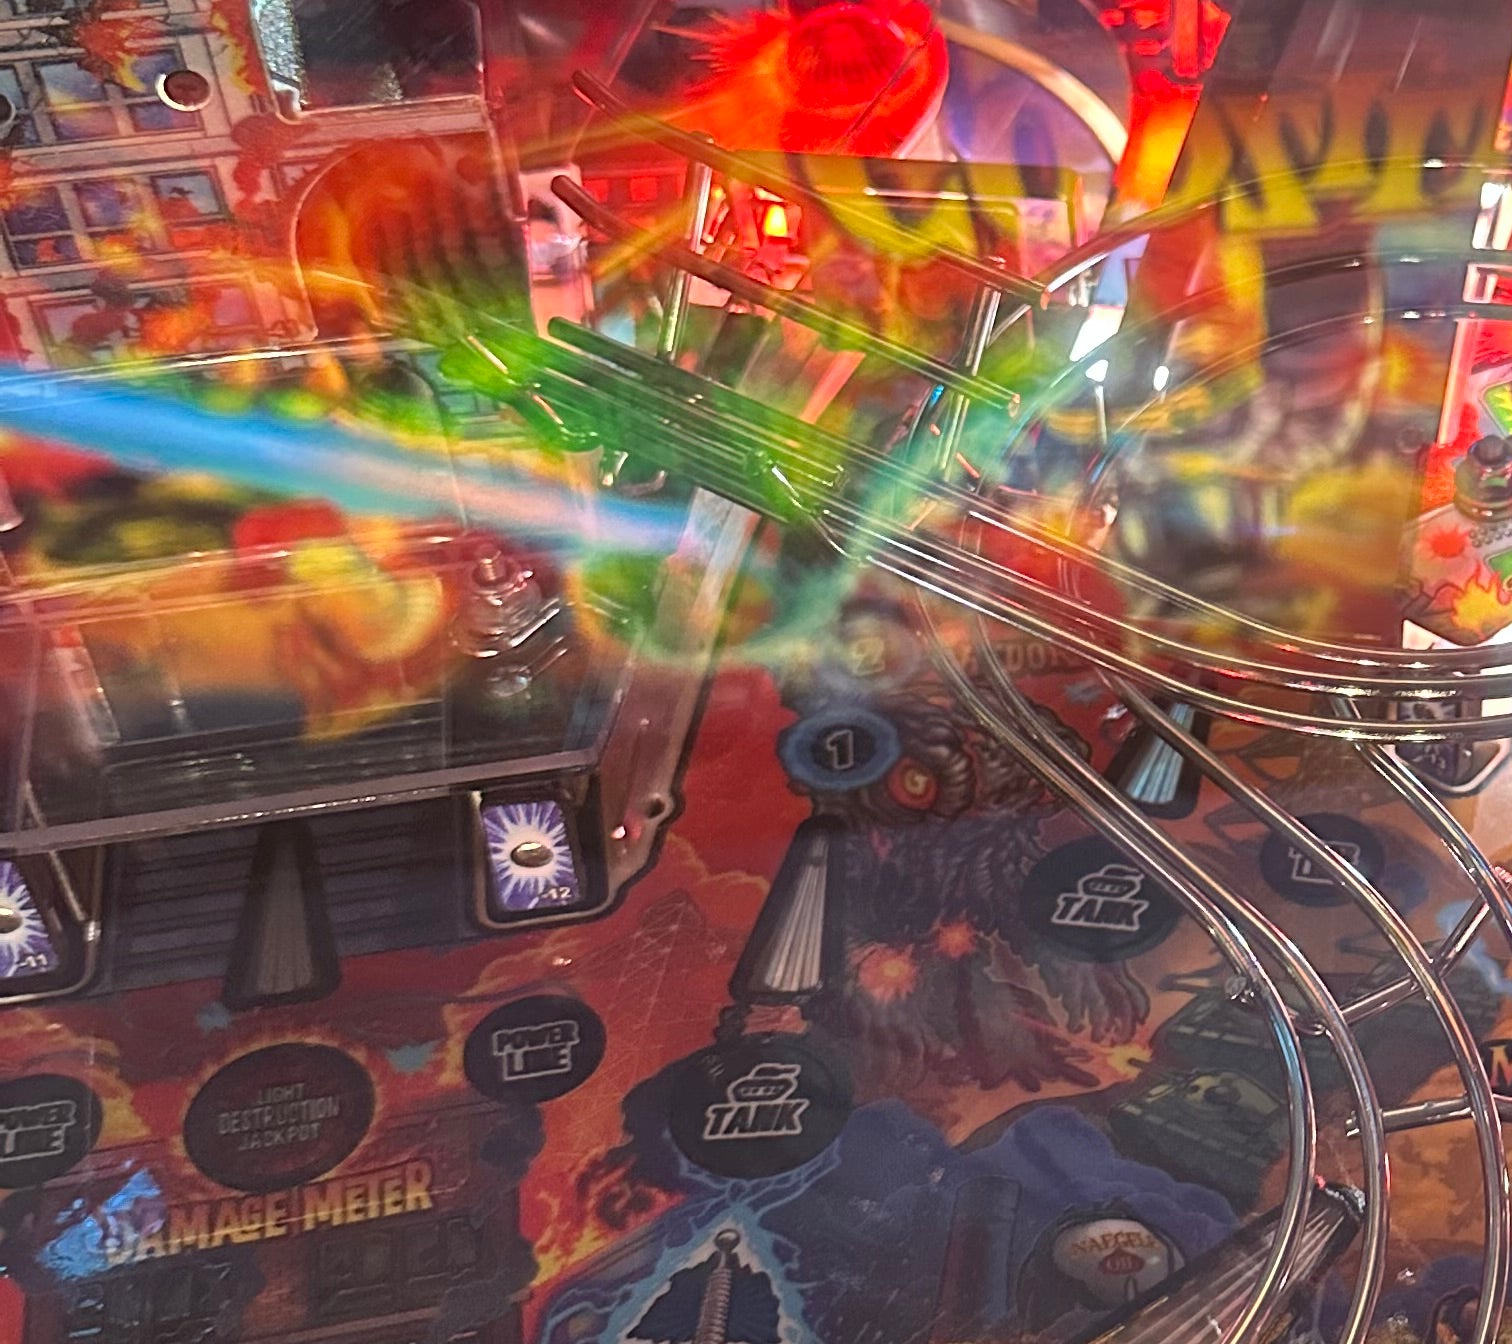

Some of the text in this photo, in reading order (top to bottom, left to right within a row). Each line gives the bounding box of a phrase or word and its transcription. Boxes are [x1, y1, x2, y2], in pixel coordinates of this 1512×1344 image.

[825, 728, 854, 770] 1
[541, 885, 573, 900] -12
[1051, 892, 1150, 932] TANK
[492, 1019, 581, 1056] POWER
[503, 1044, 573, 1081] LINE
[256, 1082, 306, 1106] LIGHT
[217, 1094, 342, 1136] DESTRUCTION
[703, 1097, 811, 1141] TANK
[237, 1121, 322, 1153] JACKPOT
[303, 1160, 434, 1232] METER
